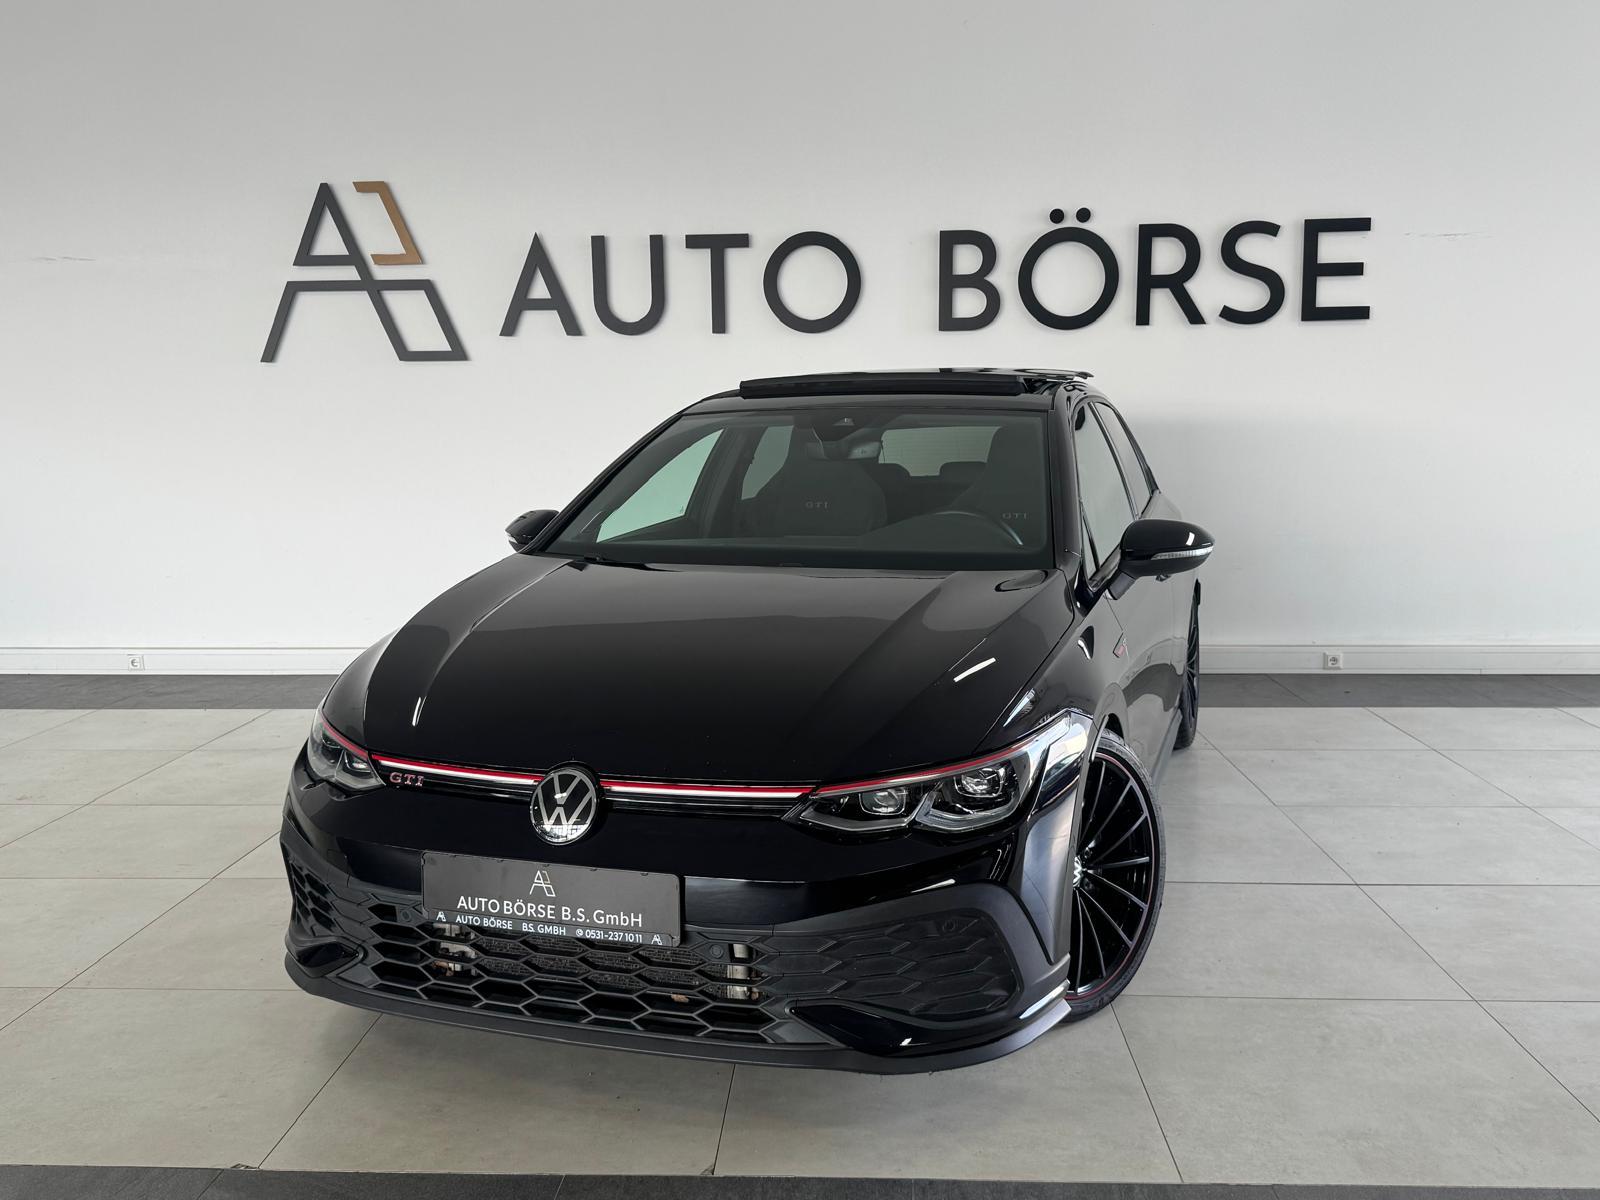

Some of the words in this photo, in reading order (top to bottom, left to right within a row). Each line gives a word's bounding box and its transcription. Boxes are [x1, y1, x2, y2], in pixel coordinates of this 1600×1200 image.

[499, 231, 863, 337] AUTO
[938, 207, 1372, 332] BÖRSE
[805, 501, 828, 509] GTI
[389, 772, 424, 787] GTI
[457, 896, 500, 913] AUTO
[503, 899, 556, 919] BÖRSE
[561, 906, 590, 923] B.S.
[593, 910, 643, 927] GmbH
[455, 914, 481, 926] AUTO
[483, 917, 513, 930] BÖRSE
[537, 924, 566, 936] GMBH
